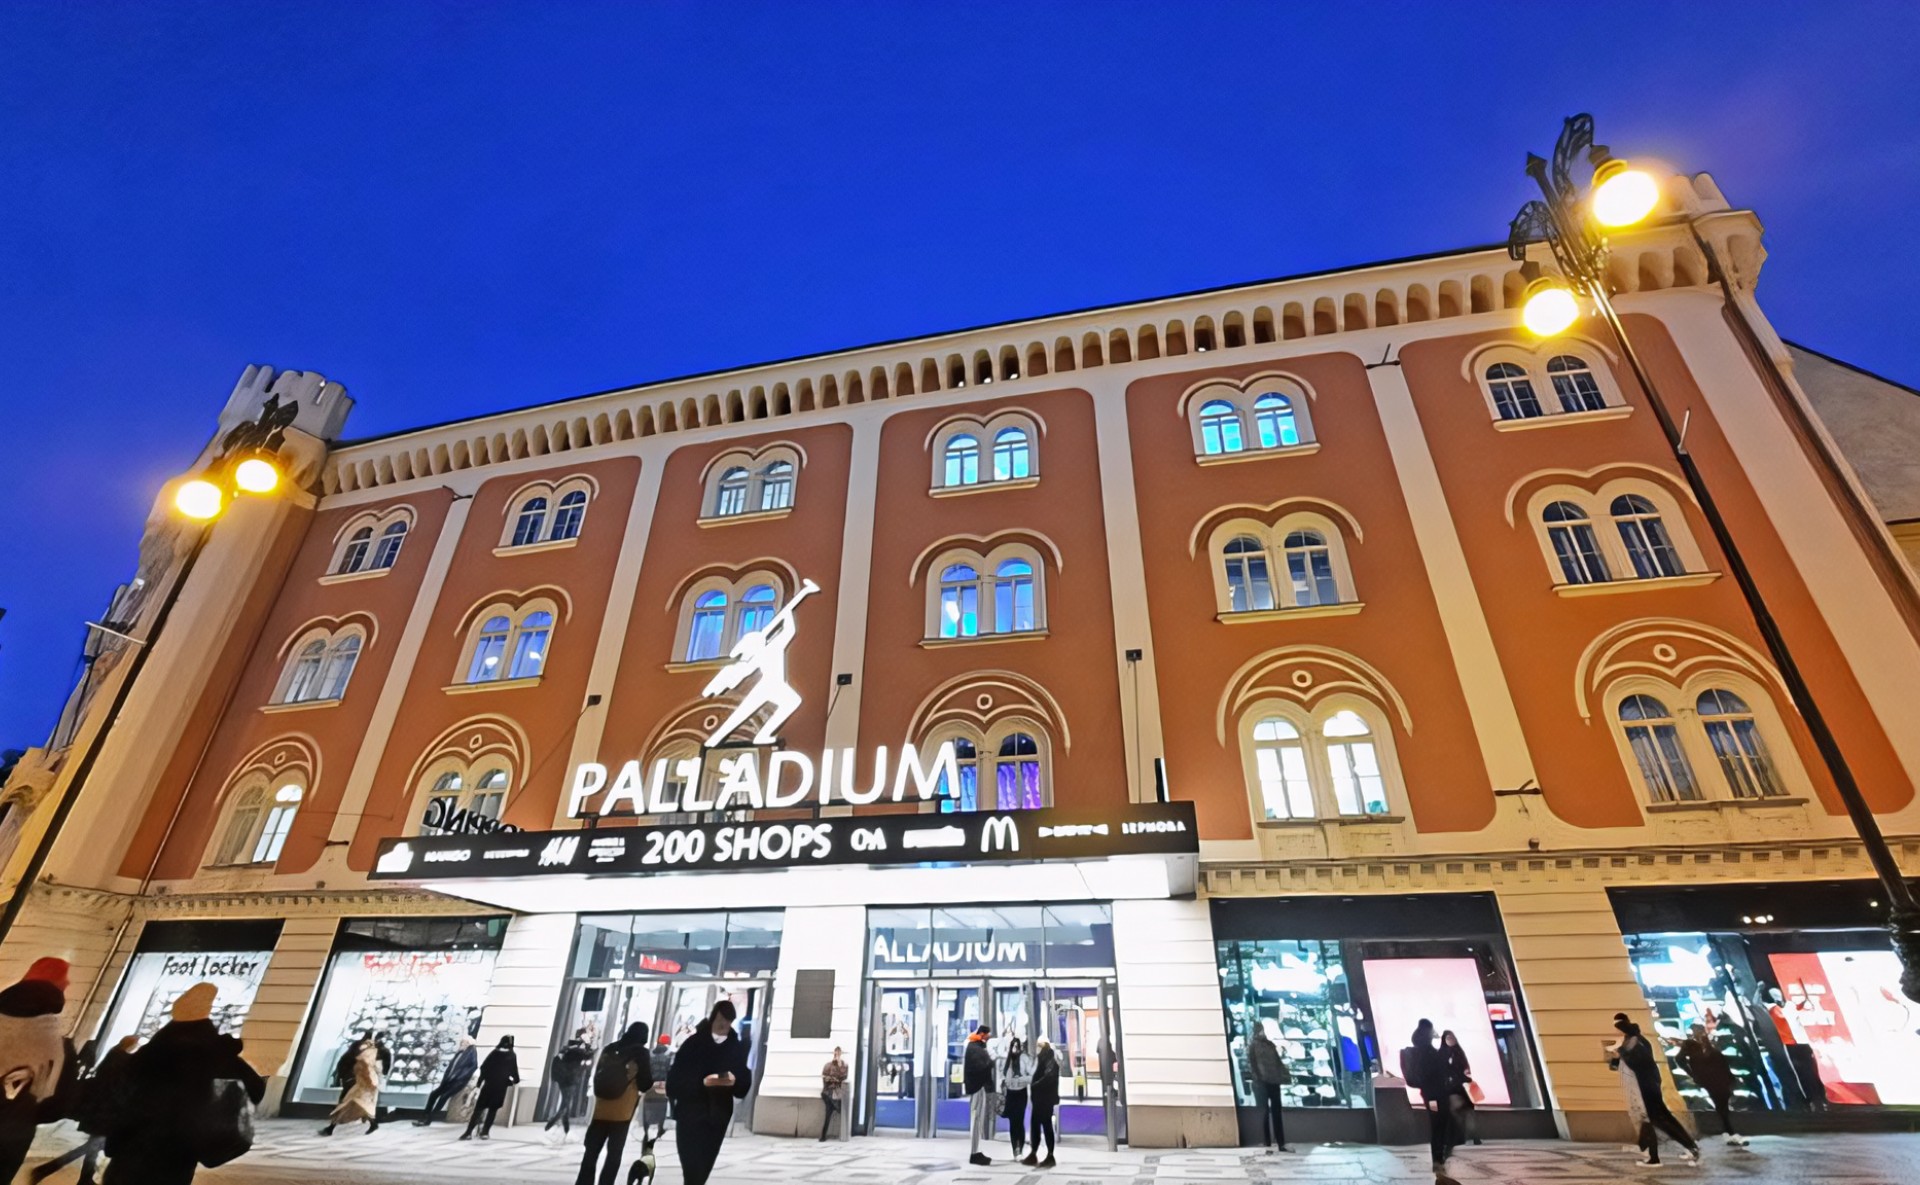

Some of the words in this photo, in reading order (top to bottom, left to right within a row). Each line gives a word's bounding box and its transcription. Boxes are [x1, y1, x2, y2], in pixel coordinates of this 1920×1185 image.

[566, 741, 961, 818] PALLADIUM
[641, 831, 705, 865] 200
[712, 823, 833, 863] SHOPS
